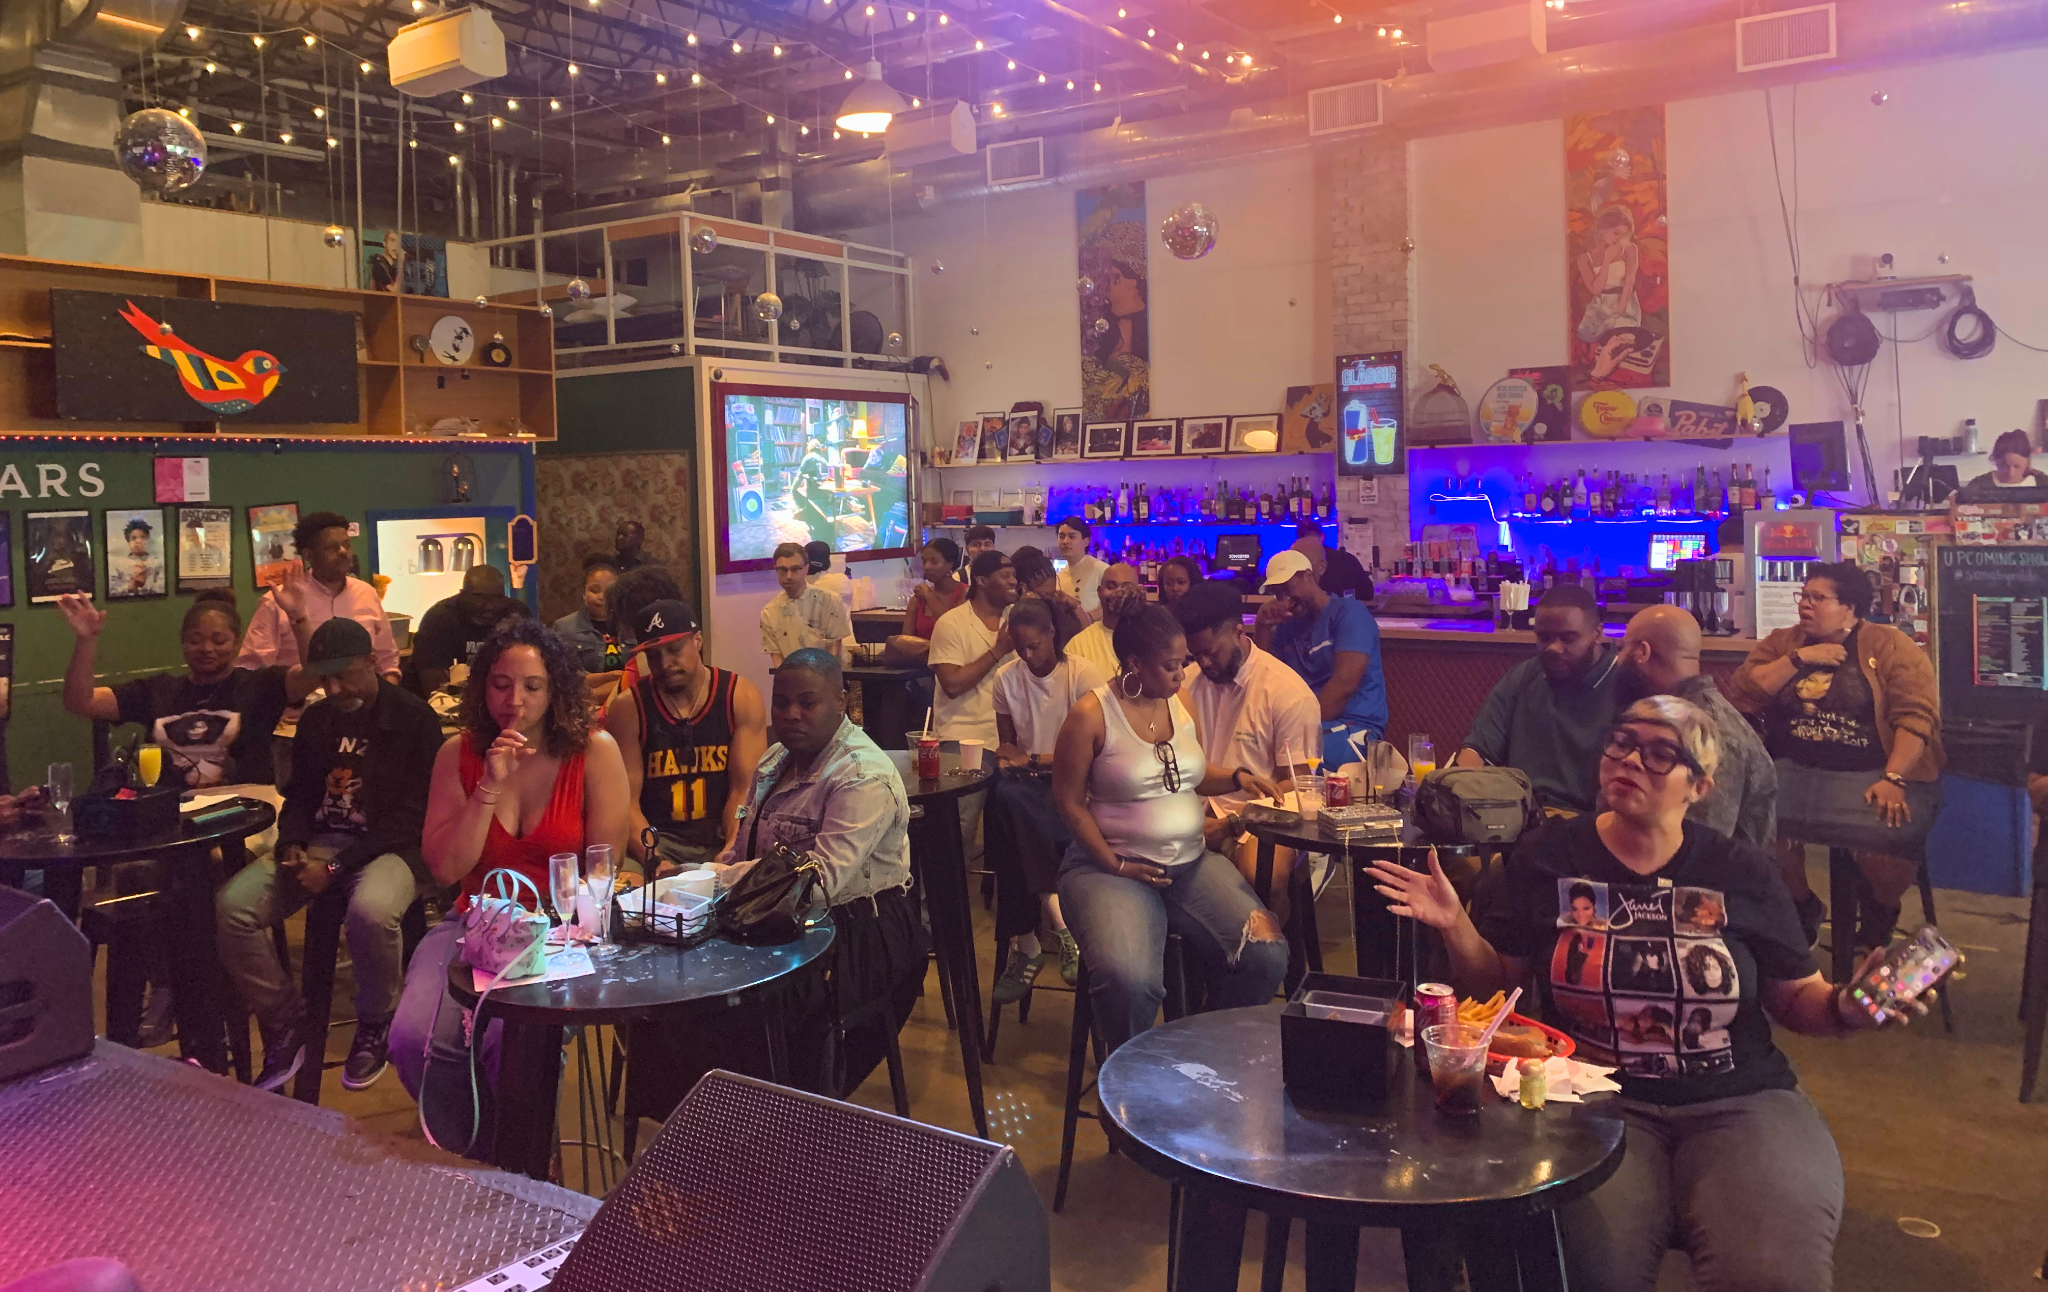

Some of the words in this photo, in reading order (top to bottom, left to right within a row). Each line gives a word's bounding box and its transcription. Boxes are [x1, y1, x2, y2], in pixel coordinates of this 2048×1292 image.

[1342, 366, 1396, 386] CLASSIC
[1593, 401, 1618, 414] Topo
[1675, 410, 1729, 439] Pabst
[1943, 550, 2017, 567] UPCOMING
[670, 778, 708, 822] 11
[1609, 889, 1671, 930] Janet
[1634, 911, 1668, 922] JACKSON
